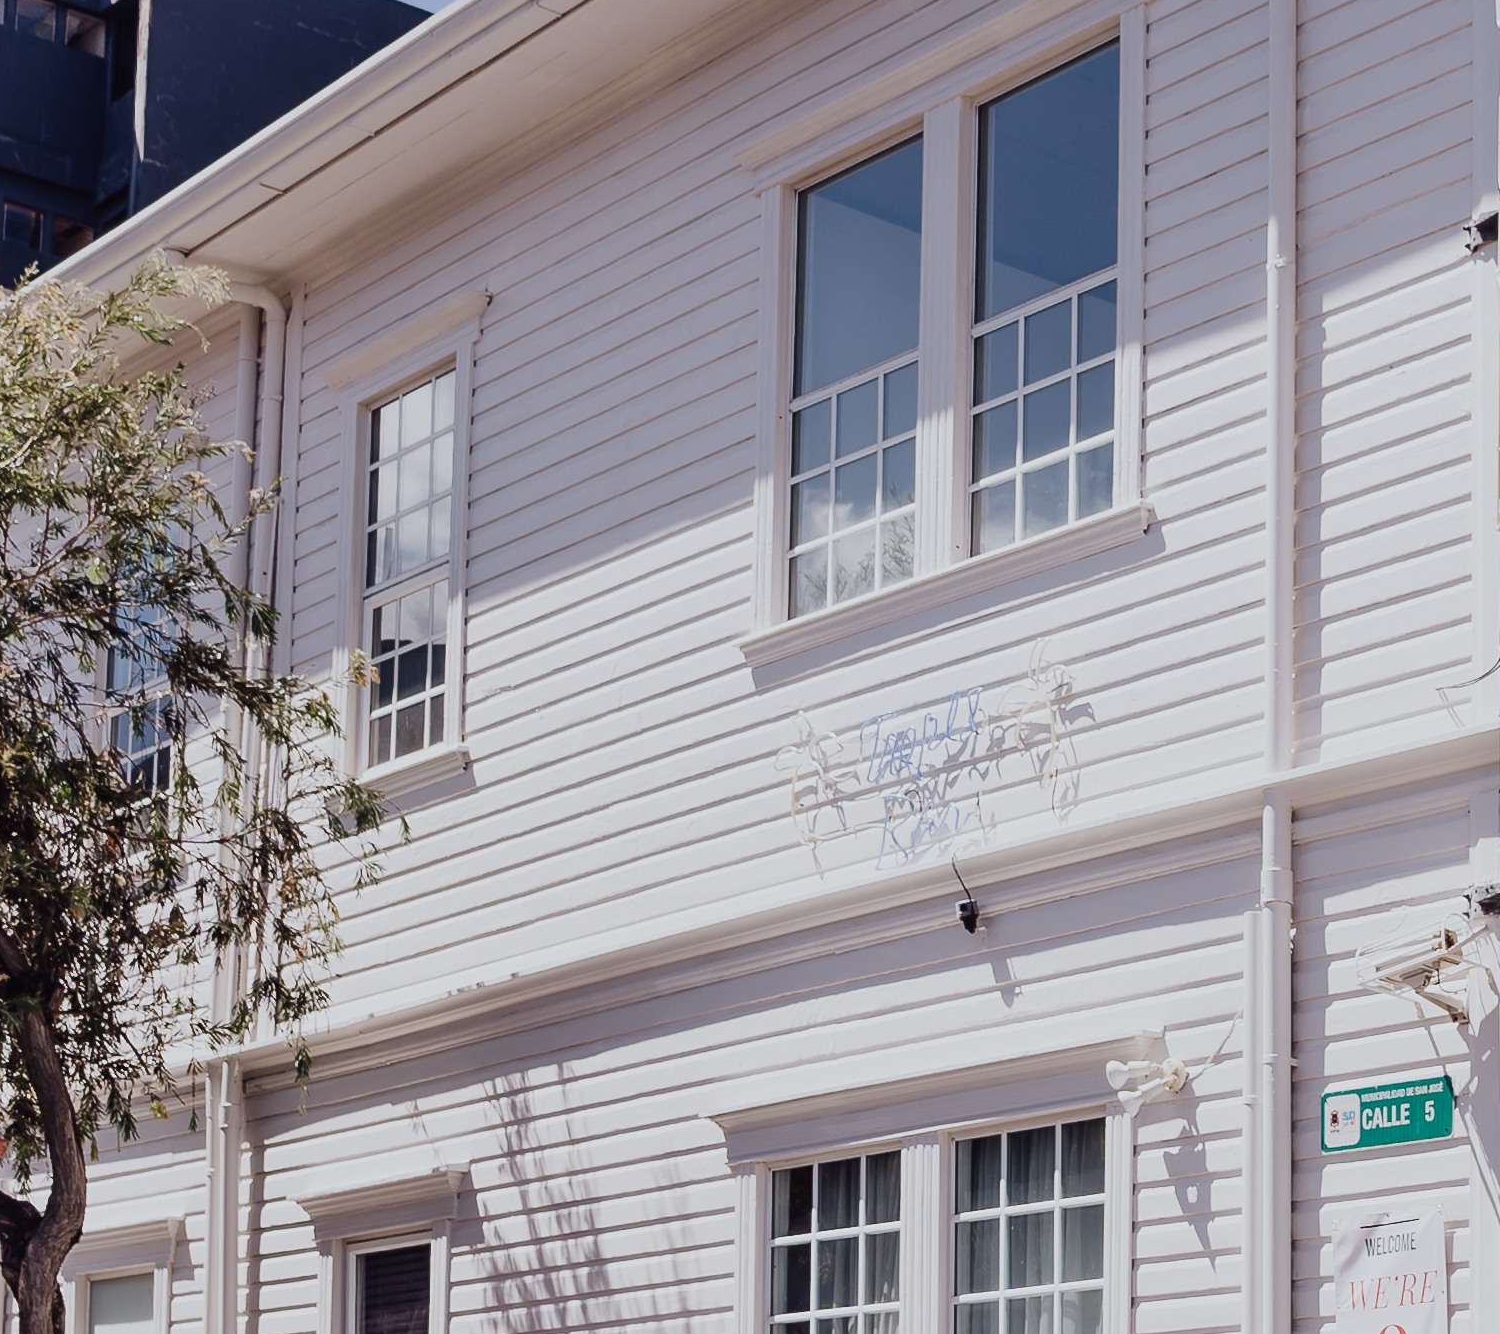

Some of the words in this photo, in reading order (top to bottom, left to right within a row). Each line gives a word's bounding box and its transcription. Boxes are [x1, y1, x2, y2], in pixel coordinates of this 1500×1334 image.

[1361, 1088, 1406, 1103] MUNICIPALIDAD
[1406, 1086, 1415, 1097] DE
[1415, 1084, 1428, 1096] SAN
[1428, 1081, 1444, 1093] JOSÉ
[1362, 1103, 1411, 1130] CALLE
[1424, 1100, 1435, 1122] 5
[1365, 1231, 1417, 1257] WELCOME
[1349, 1270, 1438, 1312] WE'RE
